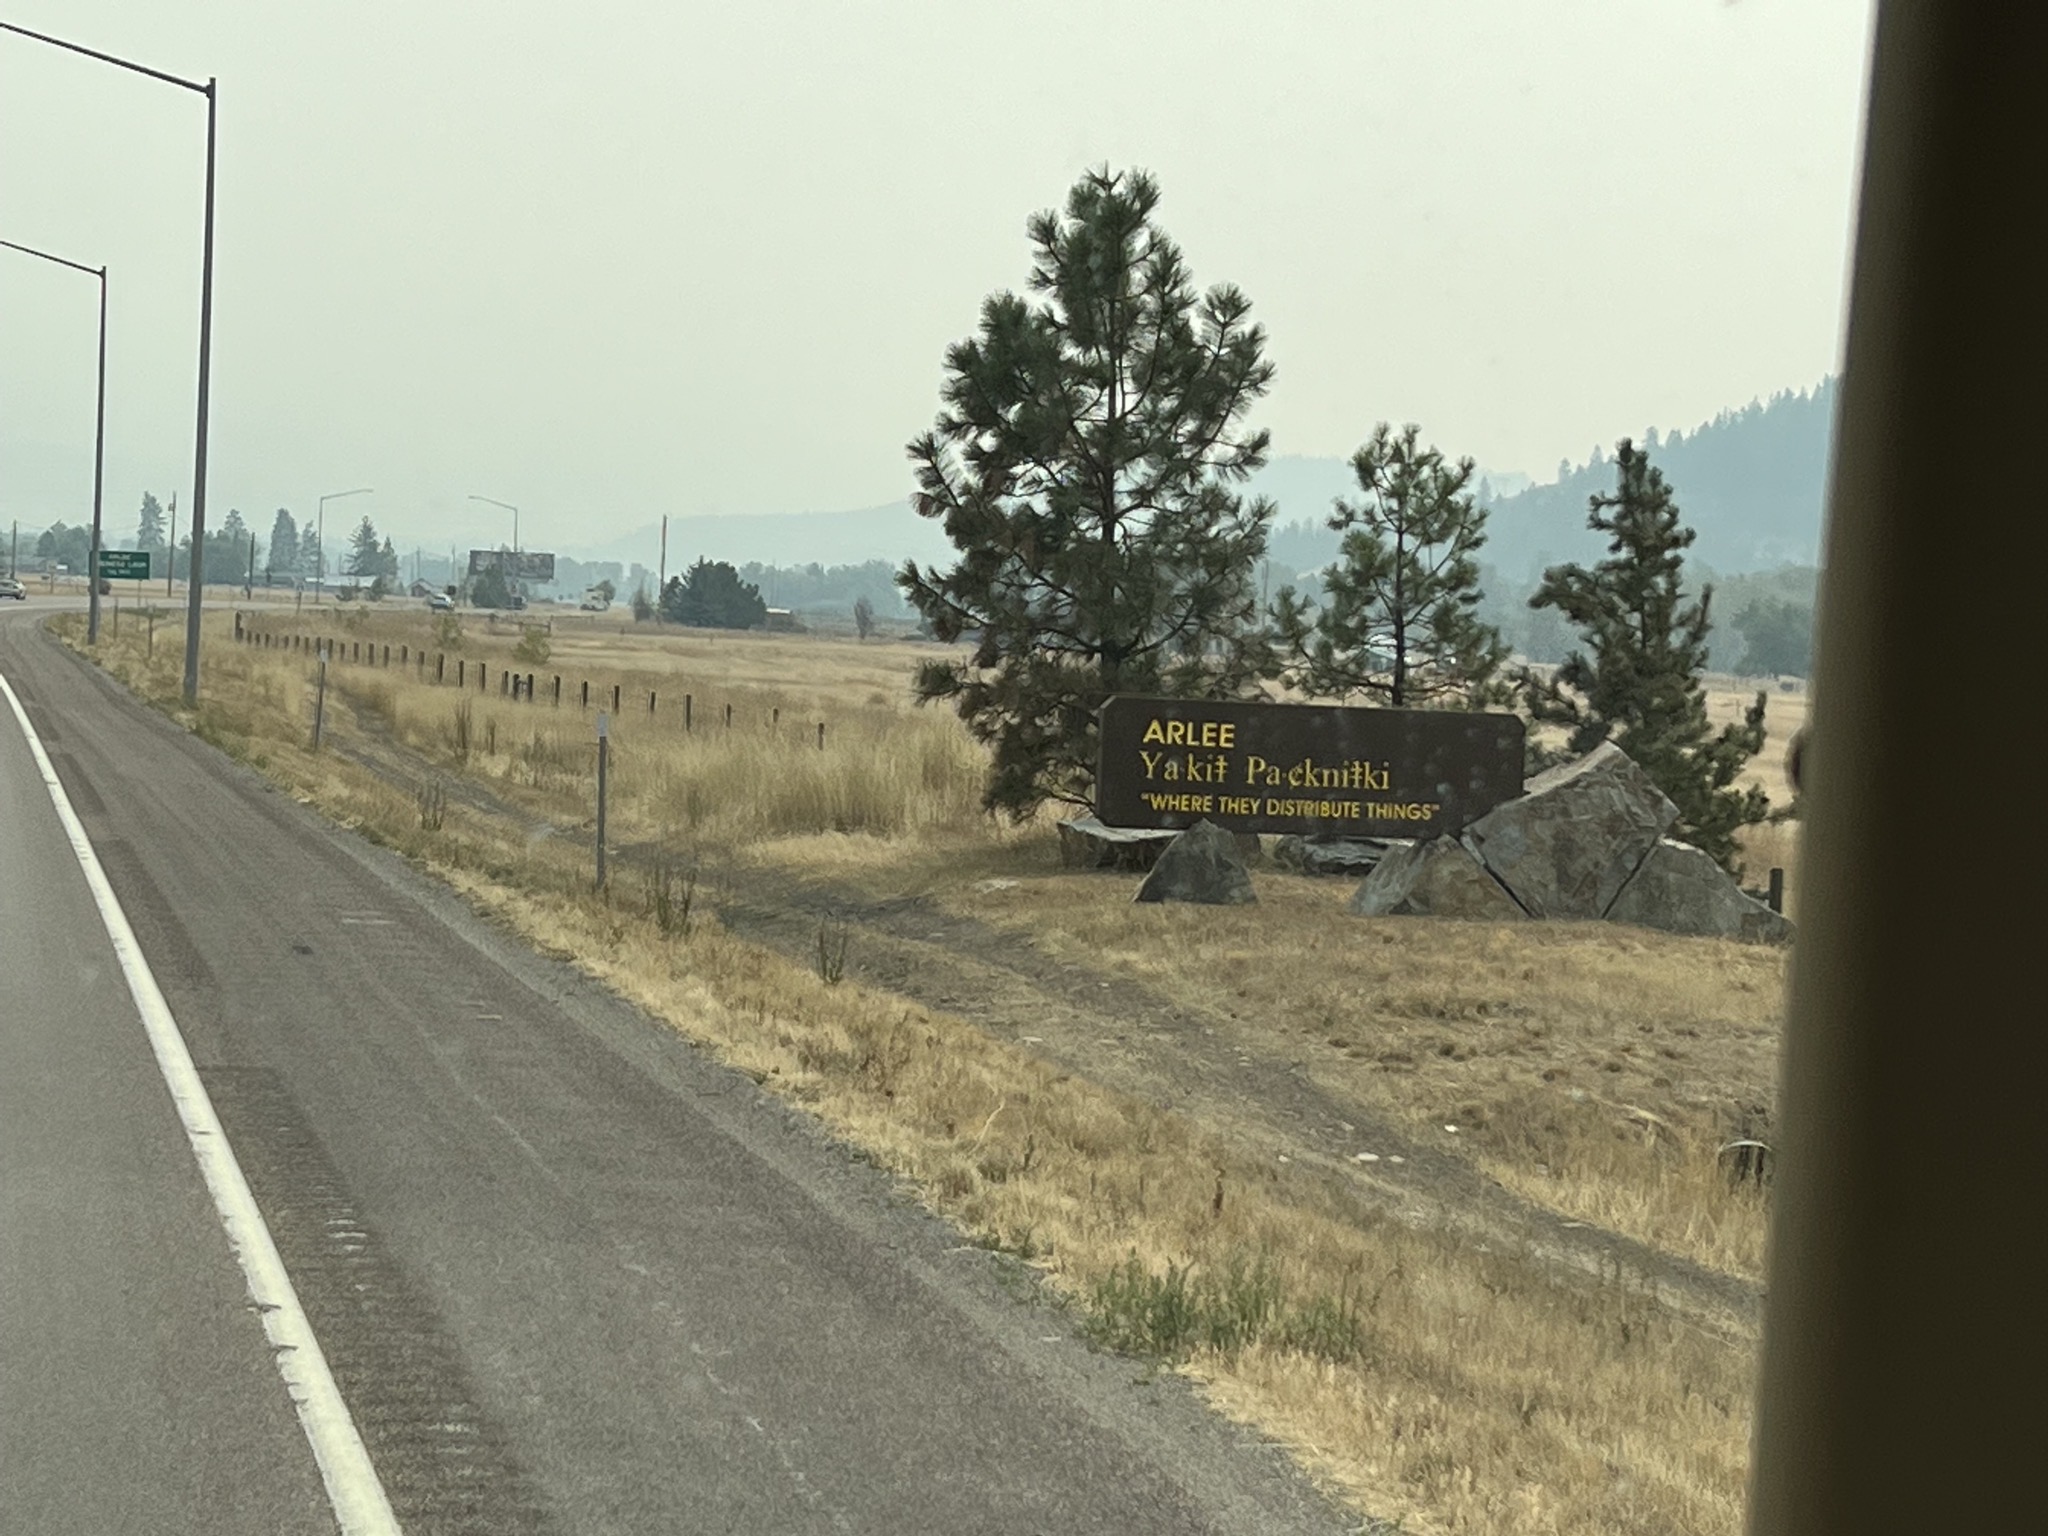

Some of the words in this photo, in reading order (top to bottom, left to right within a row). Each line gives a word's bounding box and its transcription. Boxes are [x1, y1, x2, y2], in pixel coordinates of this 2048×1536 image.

[1142, 719, 1236, 748] ARLEE
[1140, 792, 1213, 812] "WHERE
[1218, 796, 1261, 815] THEY
[1266, 798, 1360, 818] DISTRIBUTE
[1366, 802, 1441, 821] THINGS"
